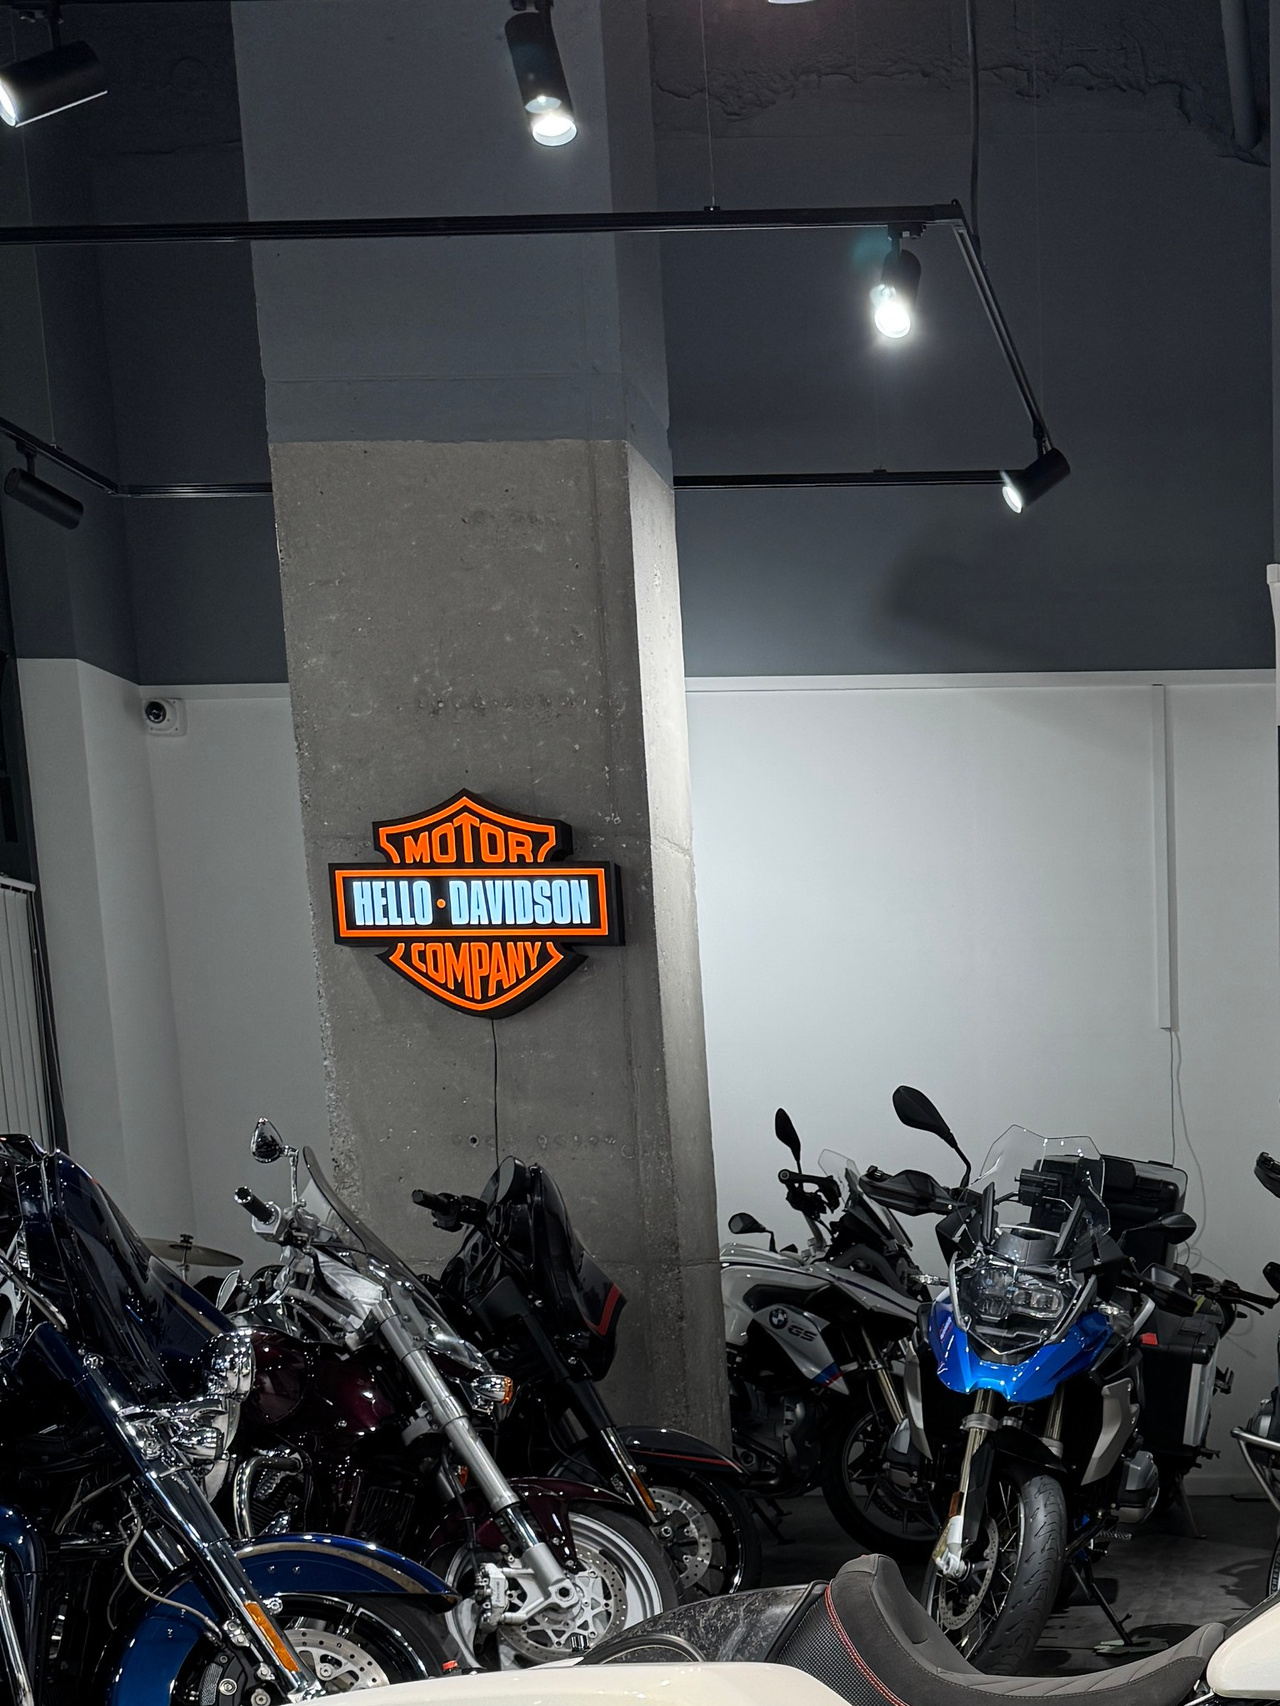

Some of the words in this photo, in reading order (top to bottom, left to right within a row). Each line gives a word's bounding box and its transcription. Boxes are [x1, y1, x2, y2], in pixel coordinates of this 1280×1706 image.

[403, 812, 534, 863] MOTOR
[352, 880, 433, 926] HELLO
[449, 880, 591, 926] DAVIDSON
[410, 941, 542, 1000] COMPANY
[788, 1325, 817, 1342] GS
